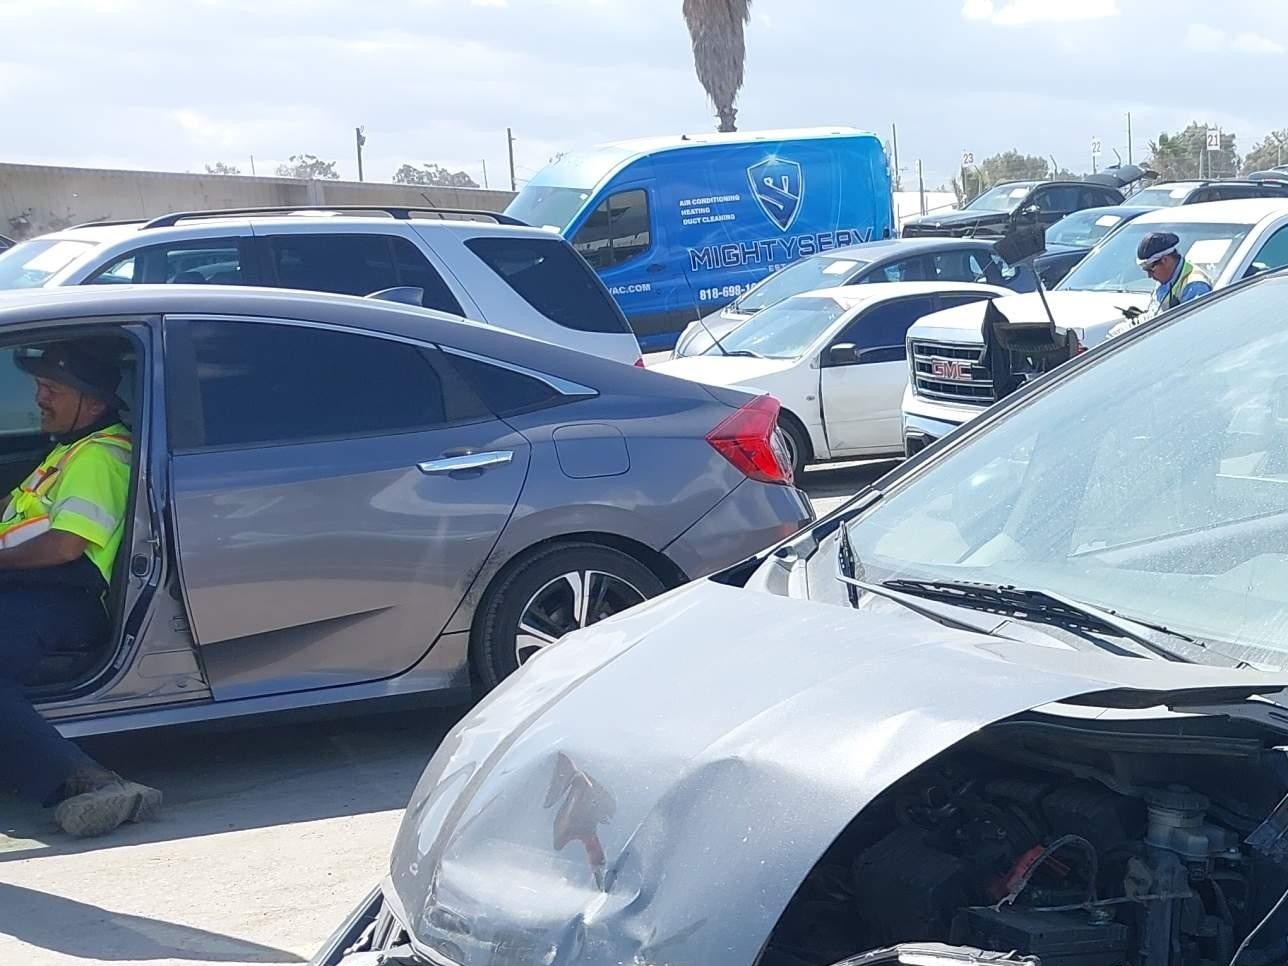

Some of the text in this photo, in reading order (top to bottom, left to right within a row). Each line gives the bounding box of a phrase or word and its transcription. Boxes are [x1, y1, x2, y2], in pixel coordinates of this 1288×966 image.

[1207, 133, 1219, 147] 21
[1092, 141, 1101, 153] 22
[963, 152, 974, 164] 23
[679, 194, 741, 207] AIR CONDITIONING
[681, 207, 711, 216] HEATING
[682, 213, 736, 226] DUCT CLEANING
[687, 226, 874, 272] MIGHTYSERV
[931, 359, 973, 380] GMC
